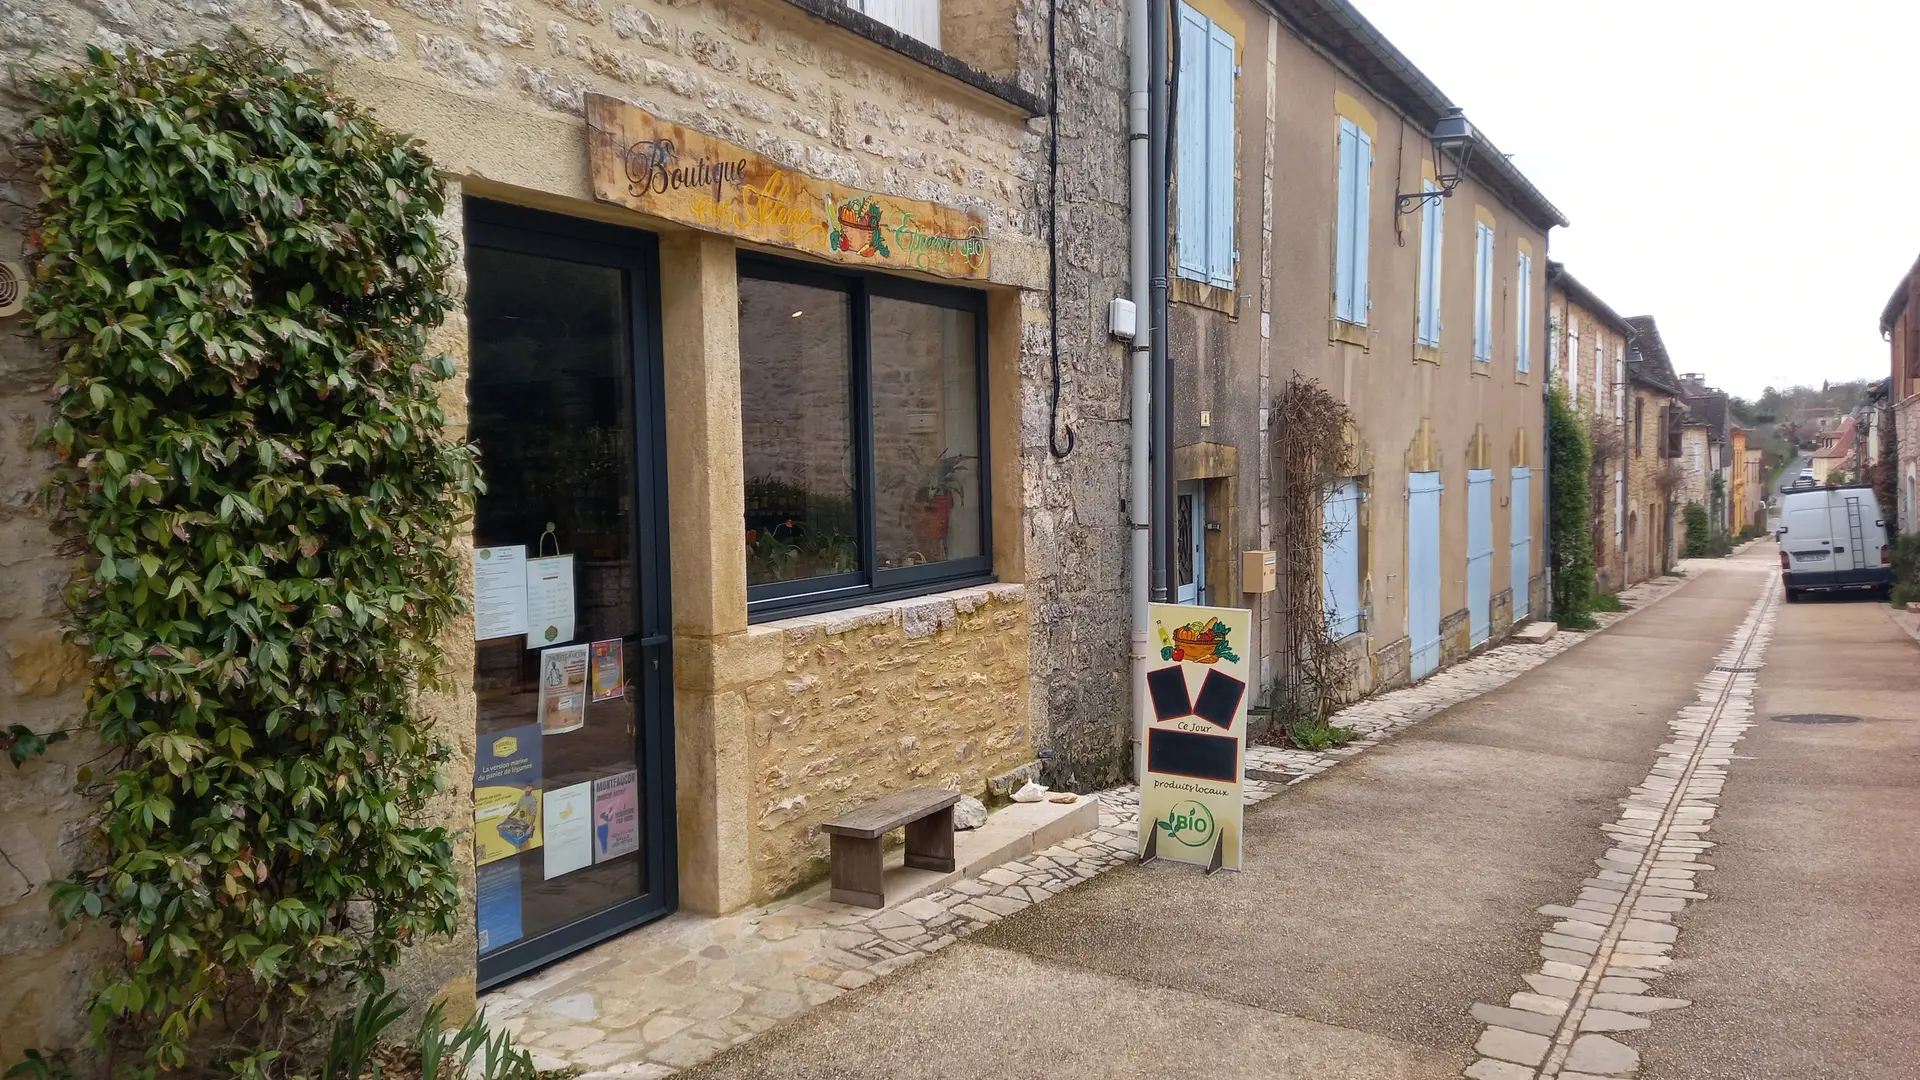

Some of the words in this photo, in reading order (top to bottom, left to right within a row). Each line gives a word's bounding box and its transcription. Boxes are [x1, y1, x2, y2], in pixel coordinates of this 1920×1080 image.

[625, 139, 747, 202] Boutique
[1177, 721, 1189, 731] Ce
[1189, 723, 1212, 733] Jour
[486, 770, 503, 781] panier
[504, 767, 511, 775] de
[512, 763, 533, 774] légumes
[490, 761, 510, 771] version
[511, 757, 529, 767] marine
[1153, 780, 1195, 793] produits
[1195, 784, 1229, 797] locaux
